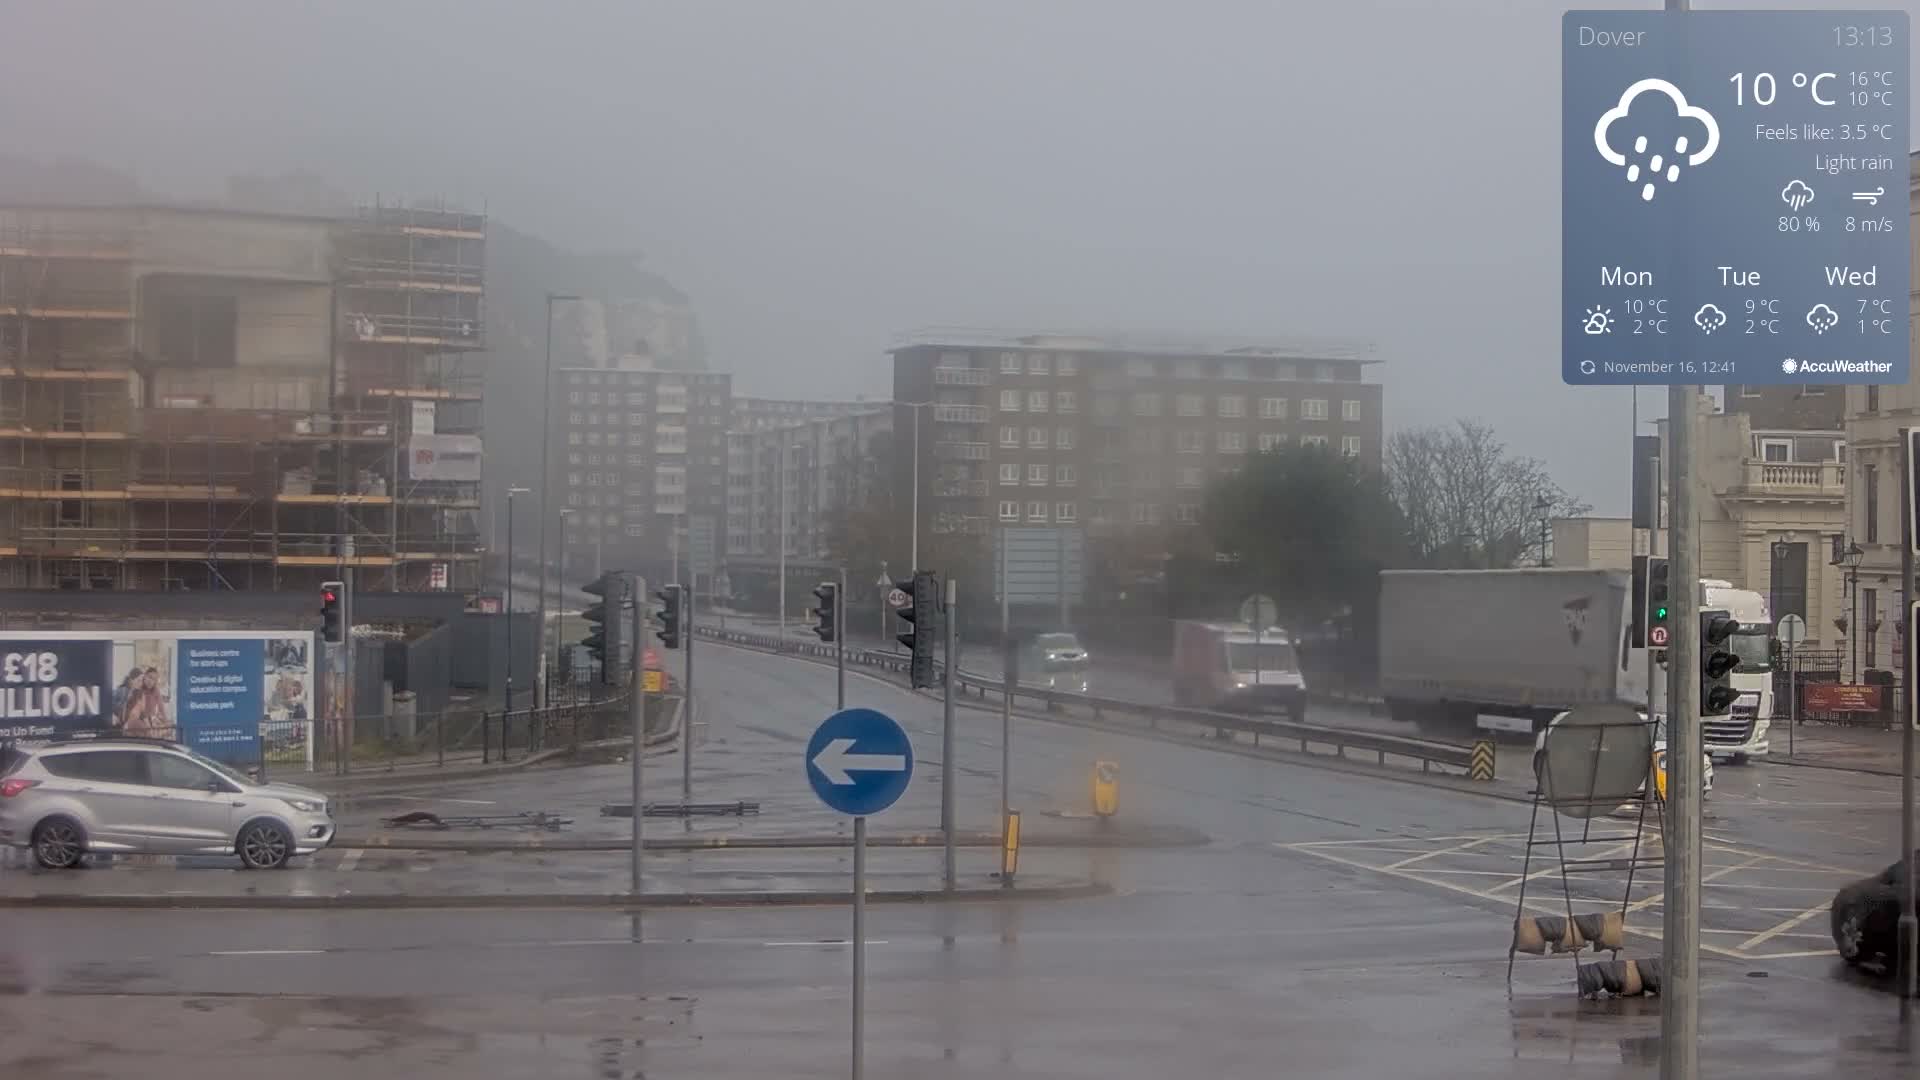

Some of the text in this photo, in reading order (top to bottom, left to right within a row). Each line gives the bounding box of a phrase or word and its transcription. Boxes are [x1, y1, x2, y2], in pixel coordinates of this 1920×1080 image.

[890, 592, 905, 602] 40
[4, 651, 58, 683] £18
[190, 676, 216, 684] Creative
